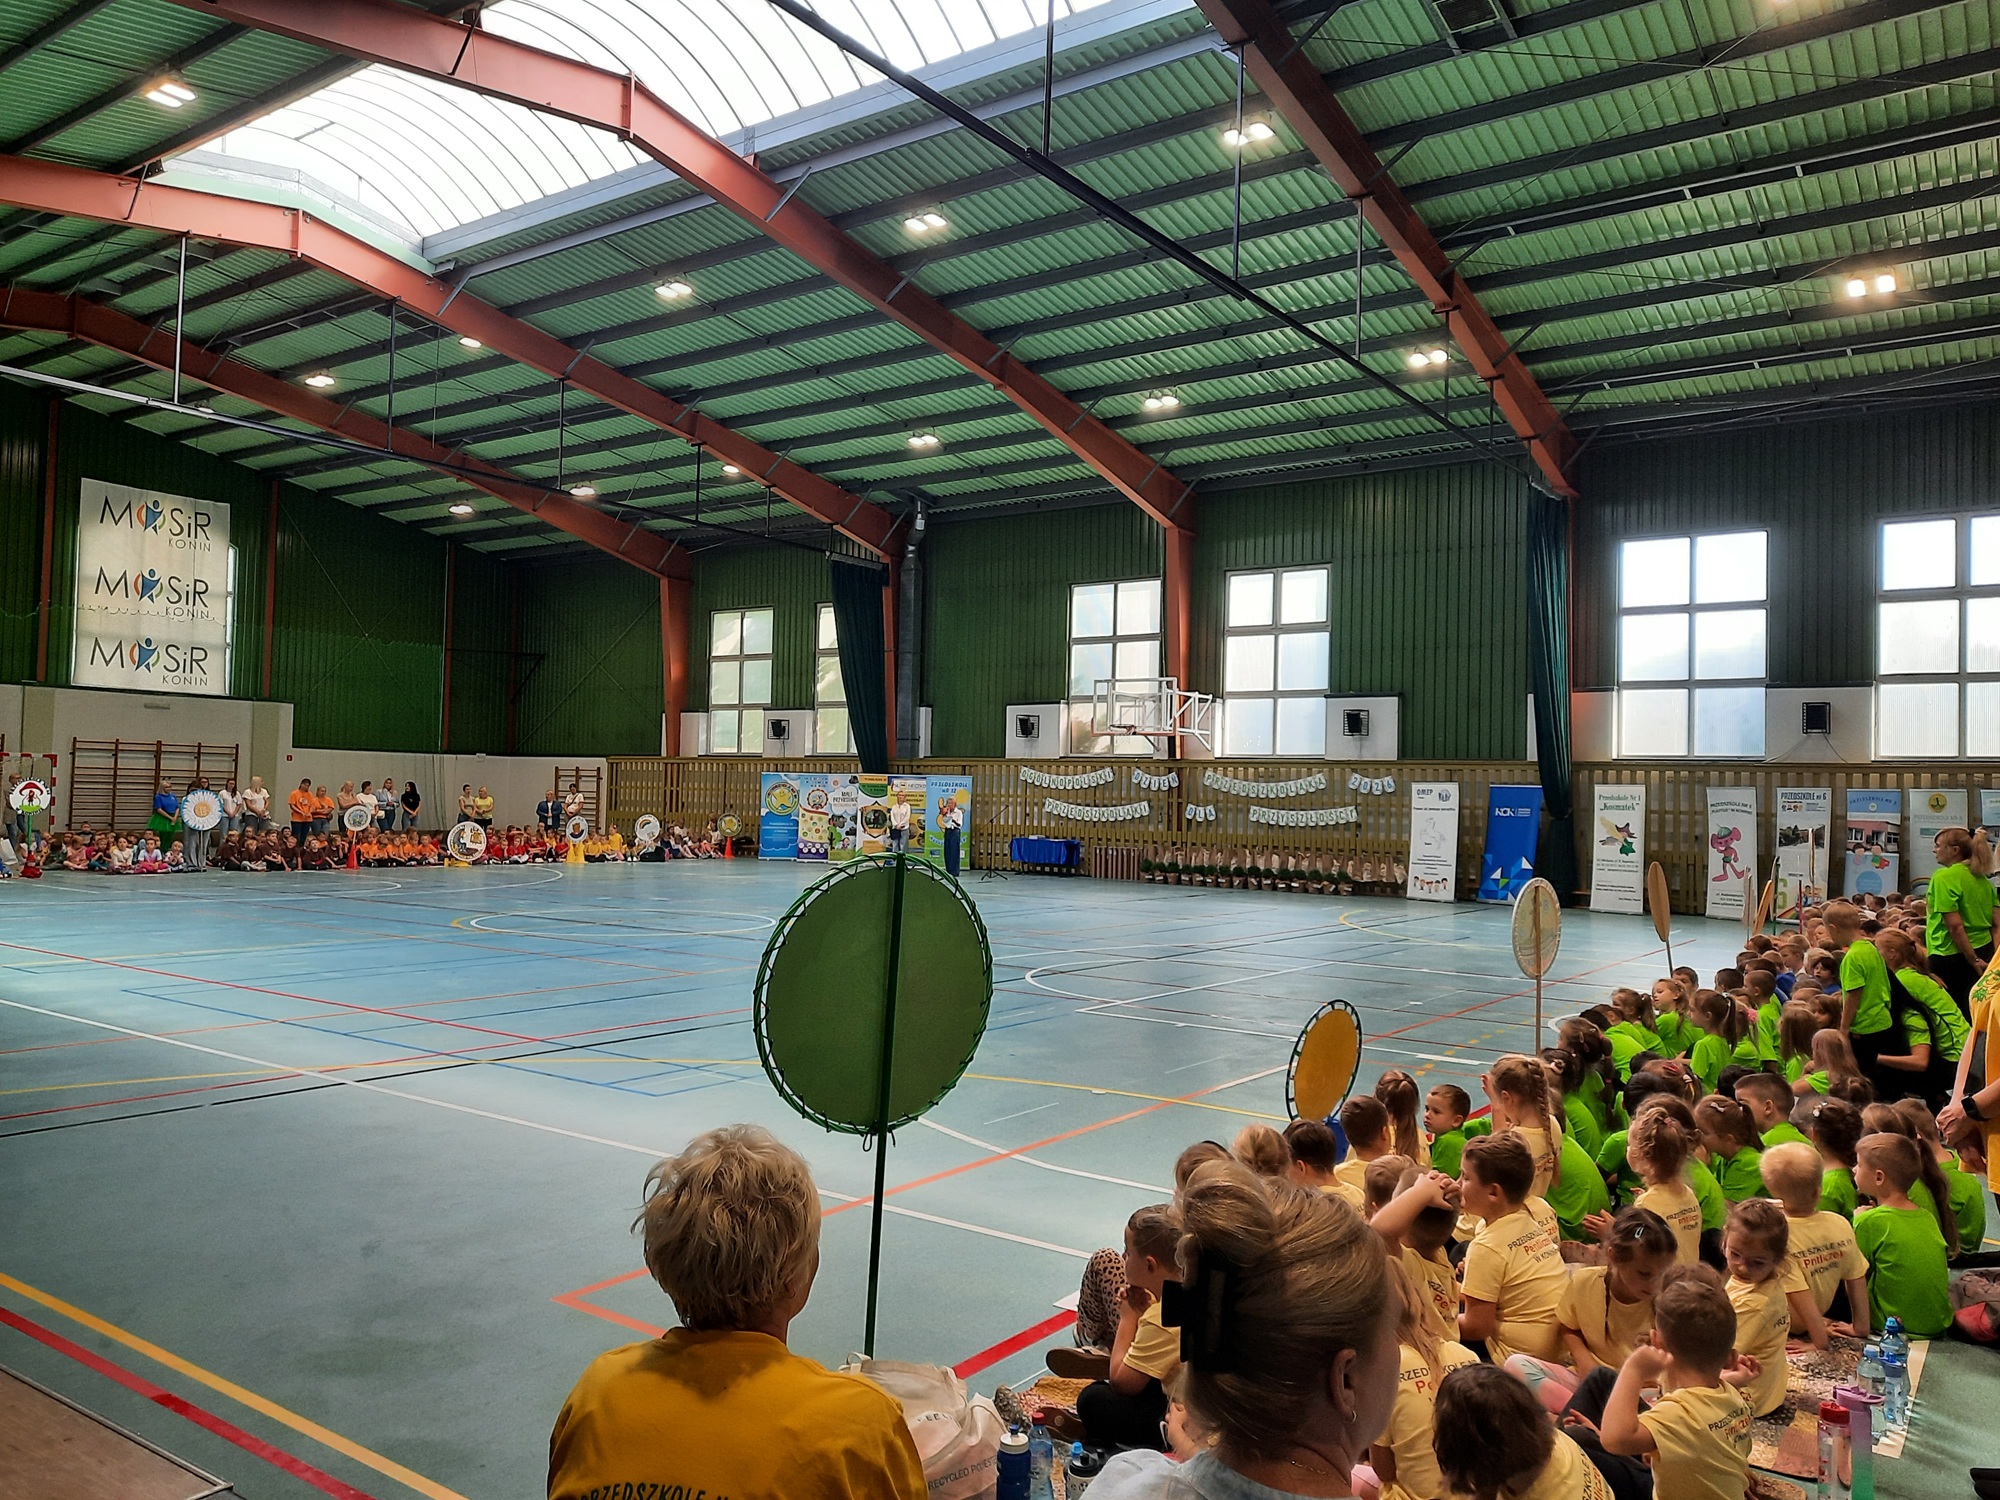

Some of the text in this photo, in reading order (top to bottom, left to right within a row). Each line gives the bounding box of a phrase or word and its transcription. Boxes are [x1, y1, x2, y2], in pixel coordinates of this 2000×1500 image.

[168, 537, 212, 552] KONIN
[165, 605, 210, 619] KONIN
[162, 674, 208, 686] KONIN
[1021, 768, 1395, 796] OGÓLNOPOLSKI DZIEŃ PRZEDSZKOLAKA 2026
[1781, 792, 1815, 801] PRZEDSZKOLE
[1822, 792, 1827, 800] 6
[1046, 799, 1149, 819] PRZEDSZKOLAKI
[1187, 804, 1215, 820] DLA
[928, 1467, 970, 1492] RECYCLED
